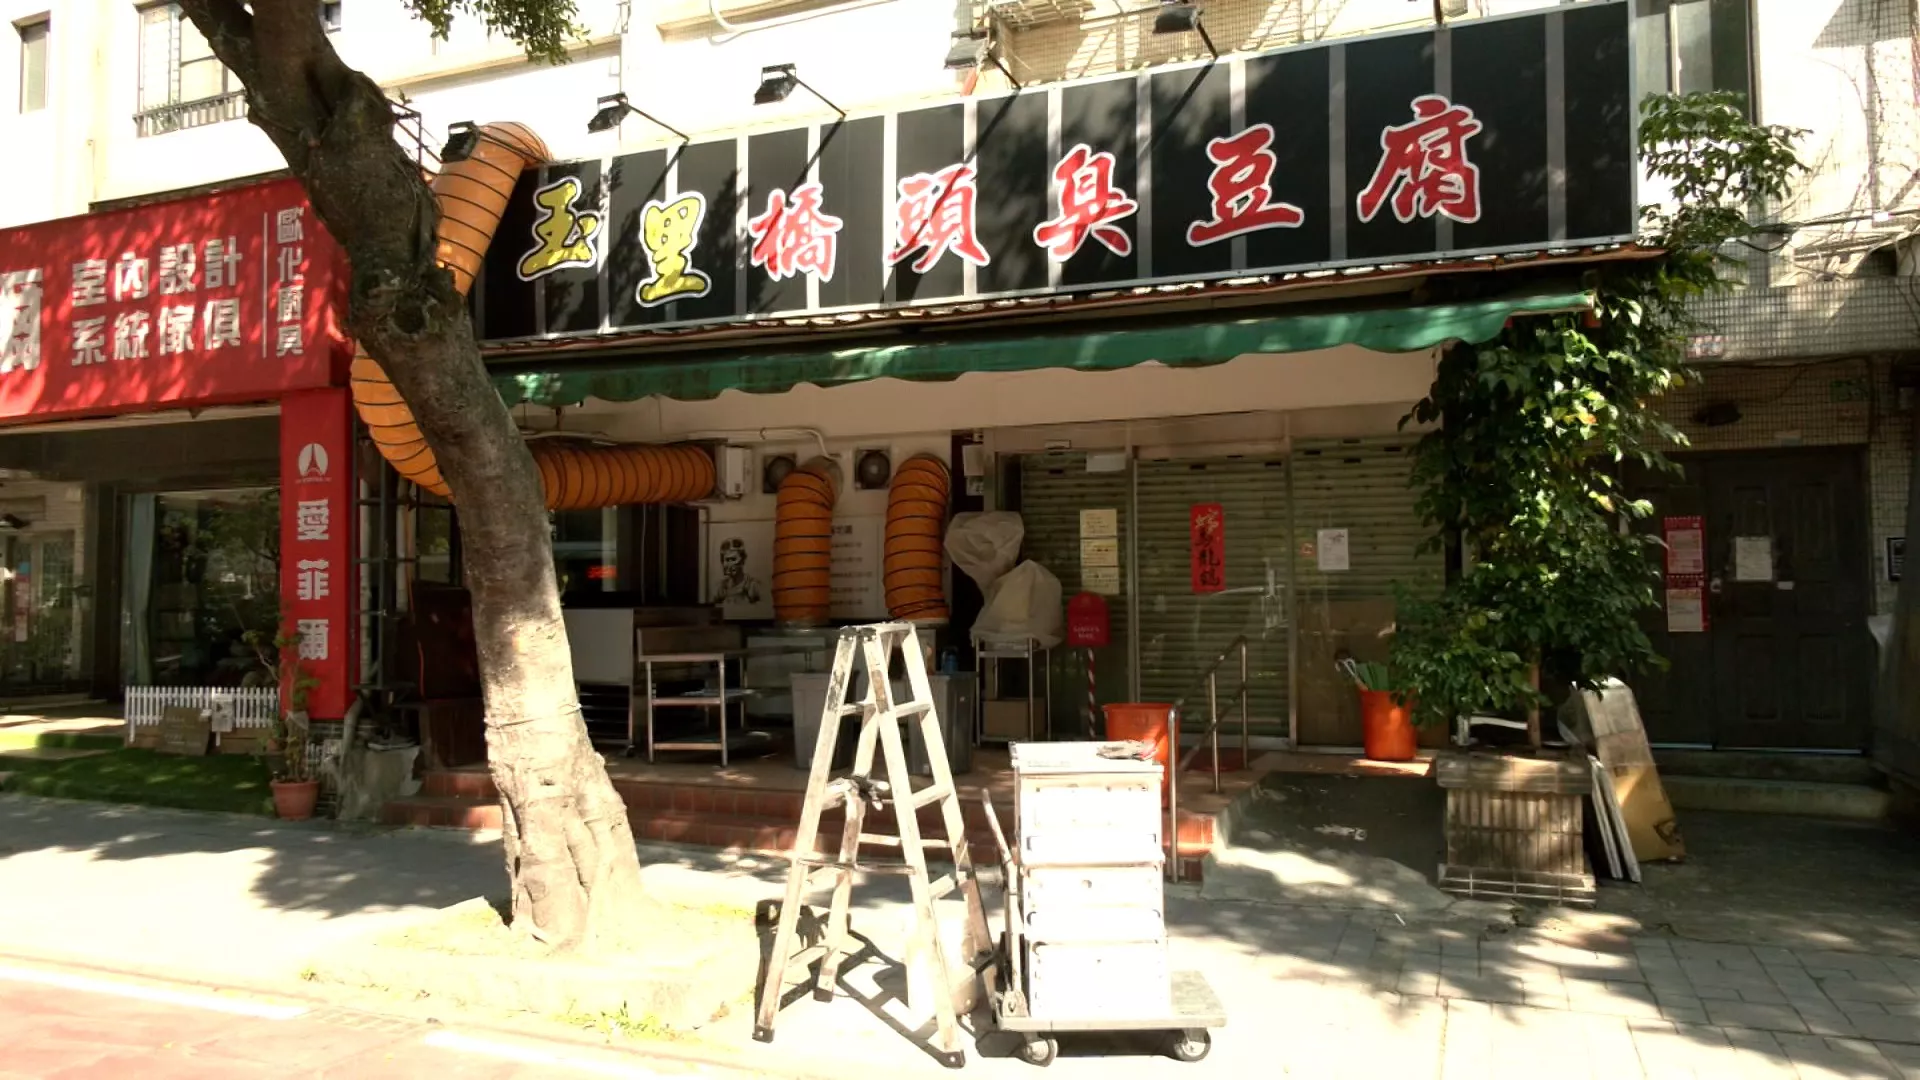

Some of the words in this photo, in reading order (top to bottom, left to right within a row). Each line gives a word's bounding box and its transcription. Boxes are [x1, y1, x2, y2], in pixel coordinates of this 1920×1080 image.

[72, 237, 243, 308] 室內設計
[276, 206, 304, 357] 歐化廚具
[71, 298, 241, 367] 系統傢俱
